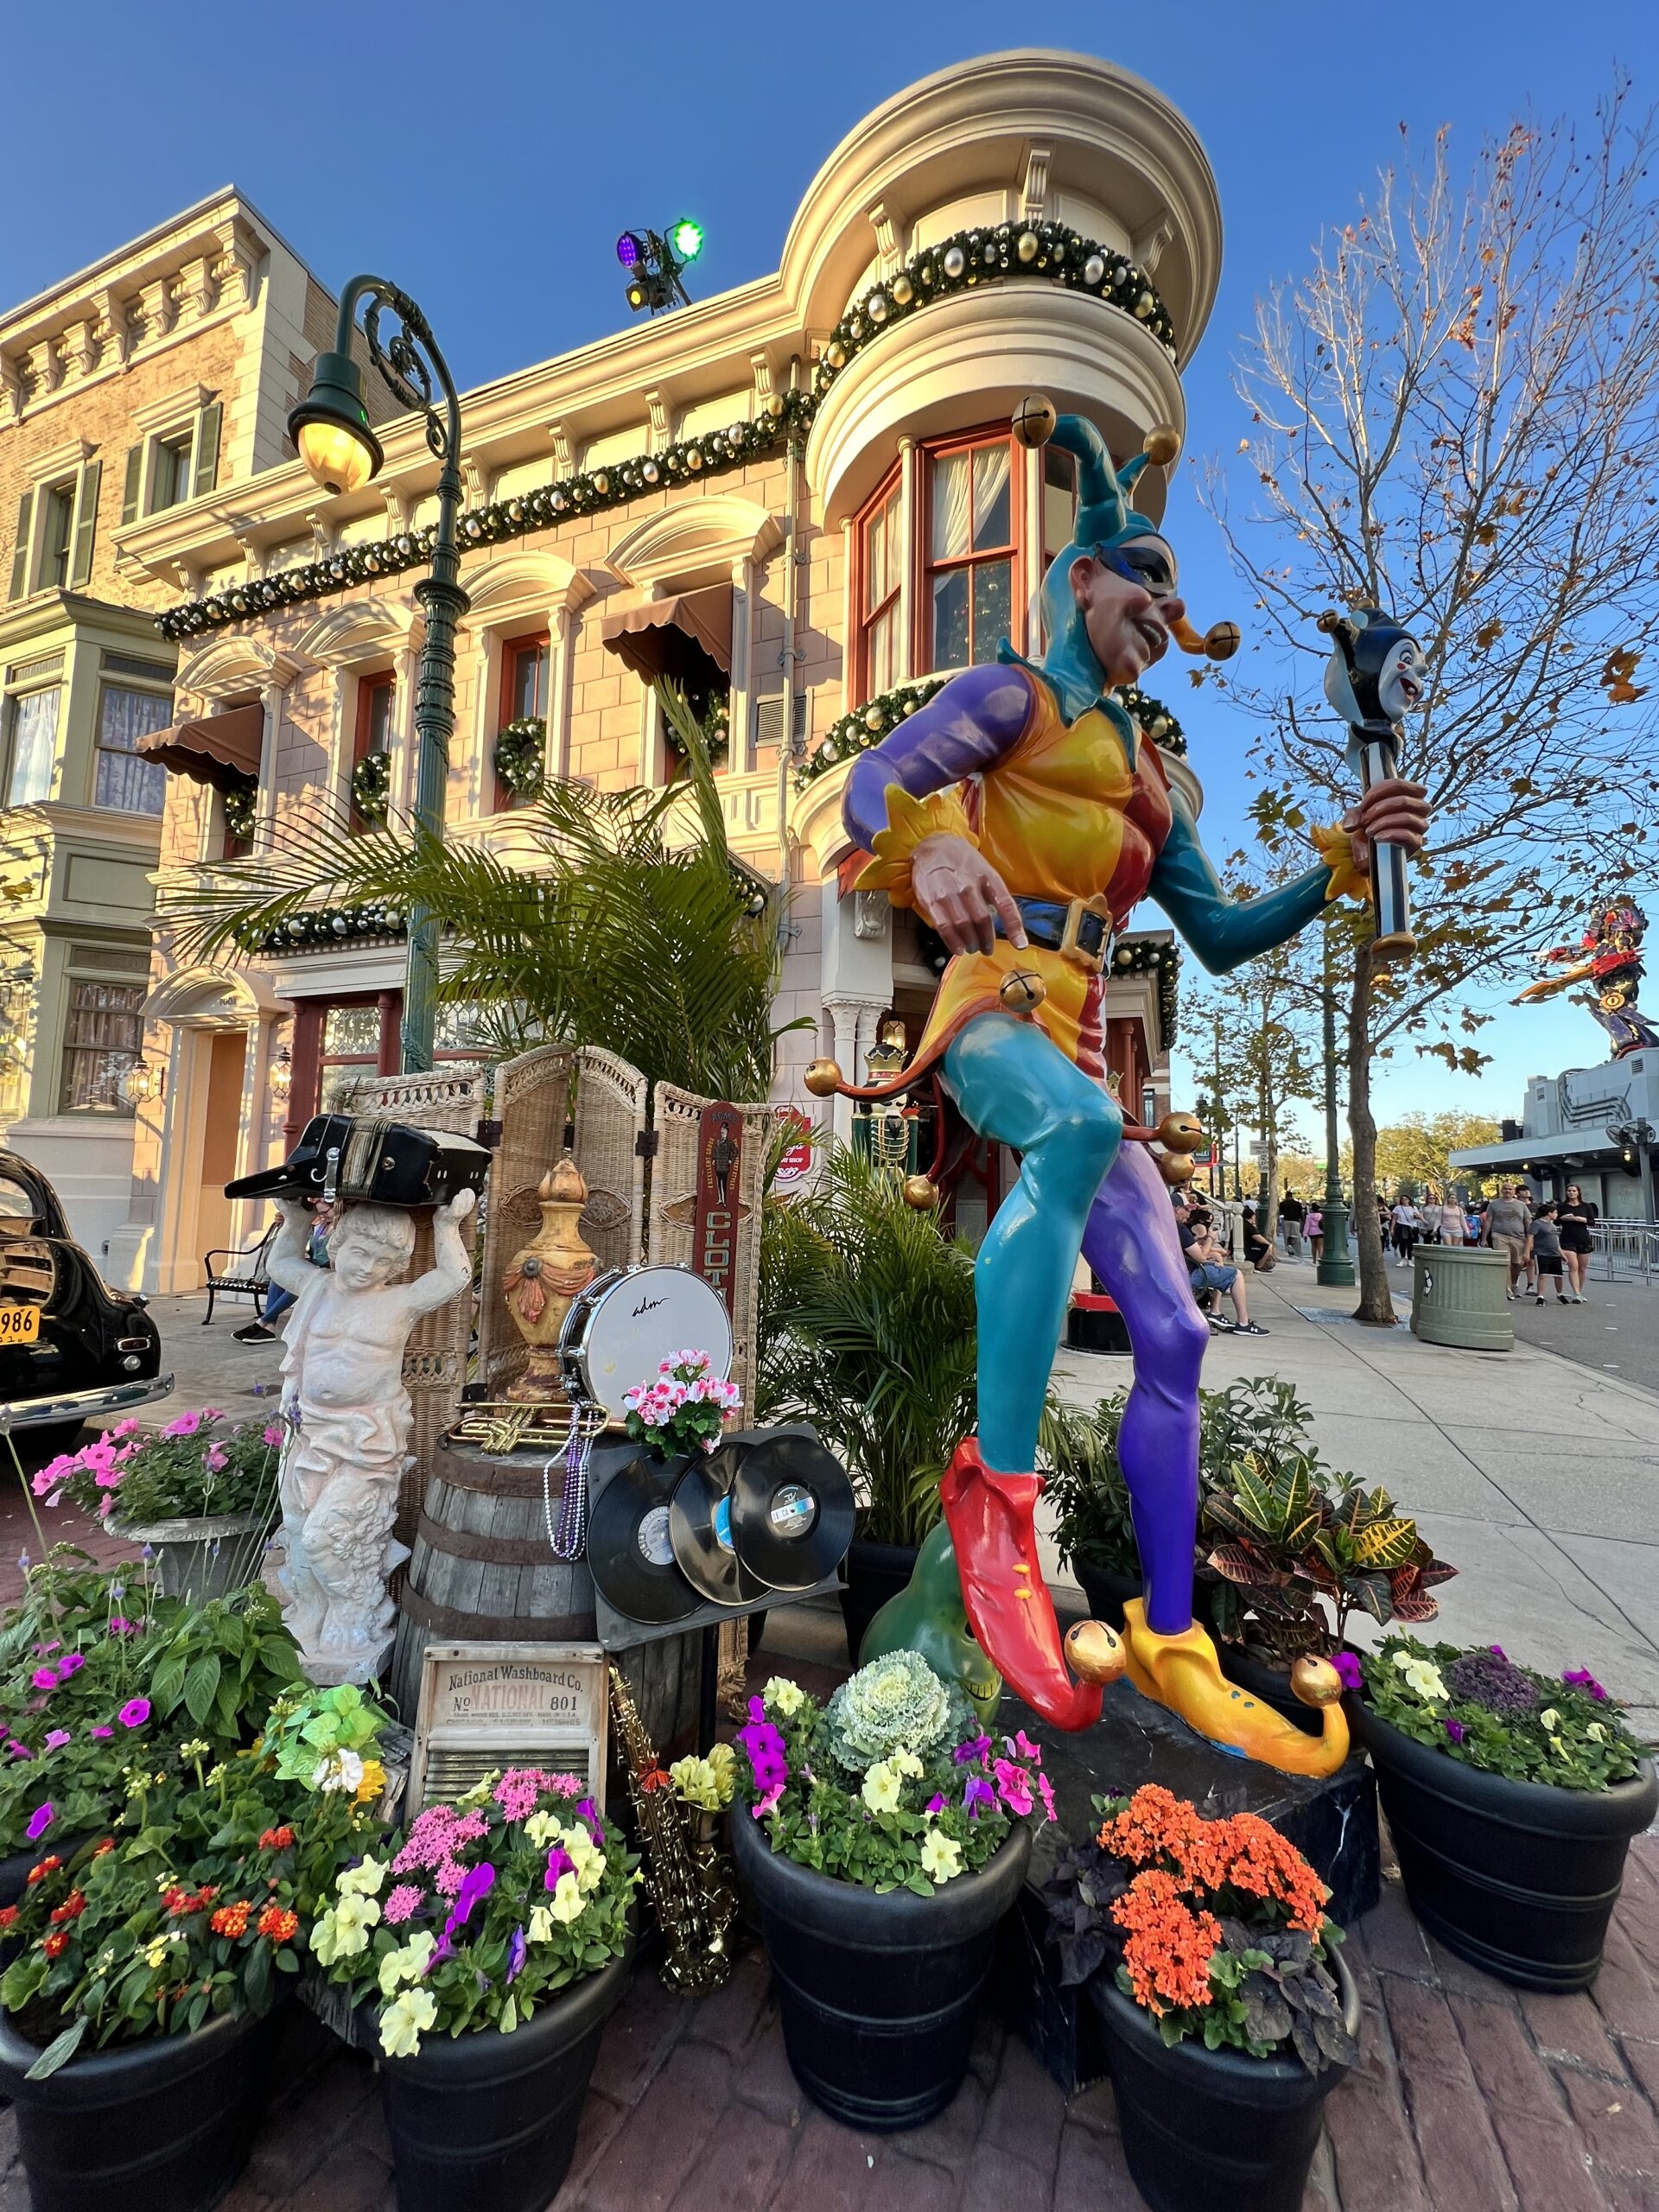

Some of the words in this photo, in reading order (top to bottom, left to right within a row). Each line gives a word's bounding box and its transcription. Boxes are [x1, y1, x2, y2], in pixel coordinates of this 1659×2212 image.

[448, 1668, 499, 1691] National
[500, 1665, 565, 1686] Washboard
[567, 1674, 583, 1693] Co.
[470, 1685, 545, 1710] NATIONAL
[550, 1696, 577, 1711] 801
